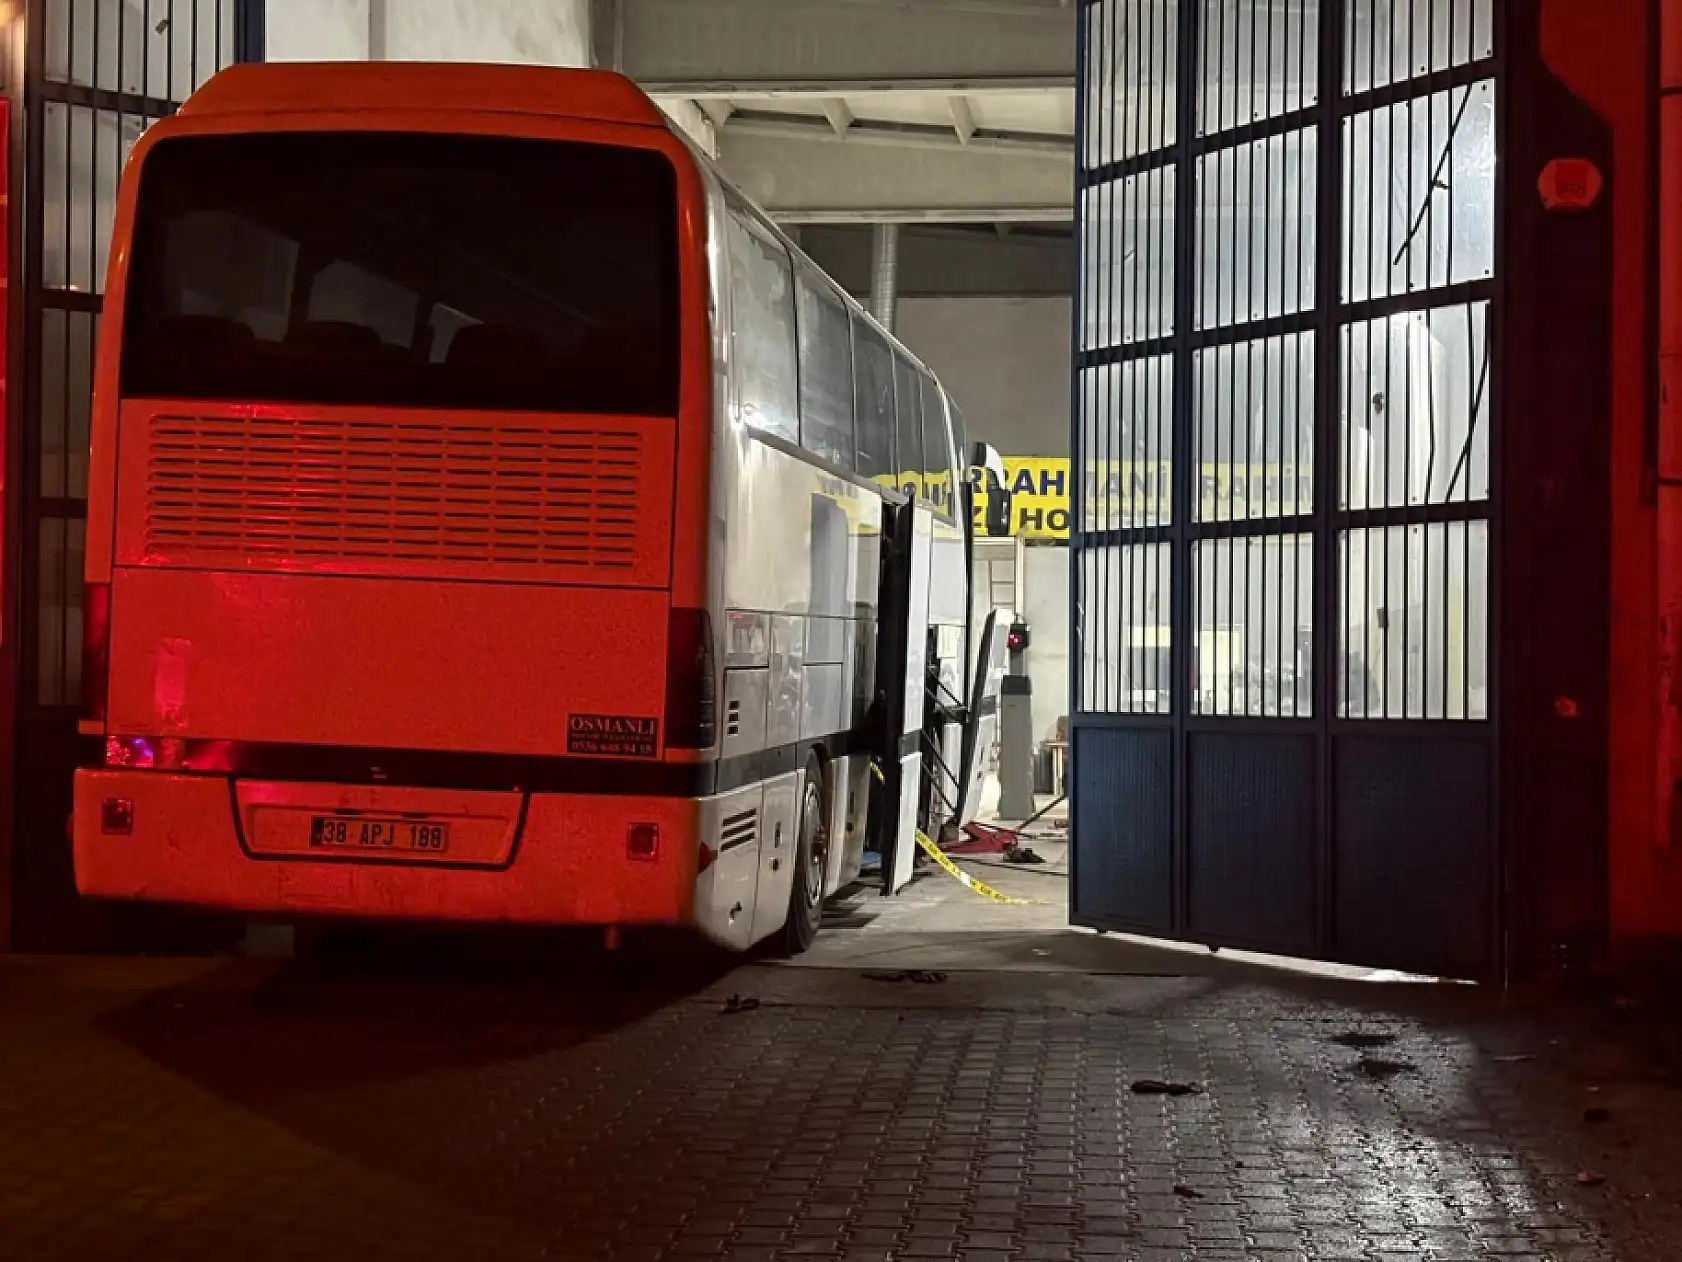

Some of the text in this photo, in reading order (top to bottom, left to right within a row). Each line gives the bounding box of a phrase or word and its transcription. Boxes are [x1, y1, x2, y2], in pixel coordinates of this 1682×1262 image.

[1019, 507, 1070, 531] HO
[570, 716, 655, 734] OSMANLI
[323, 820, 442, 848] 38 APJ 188
